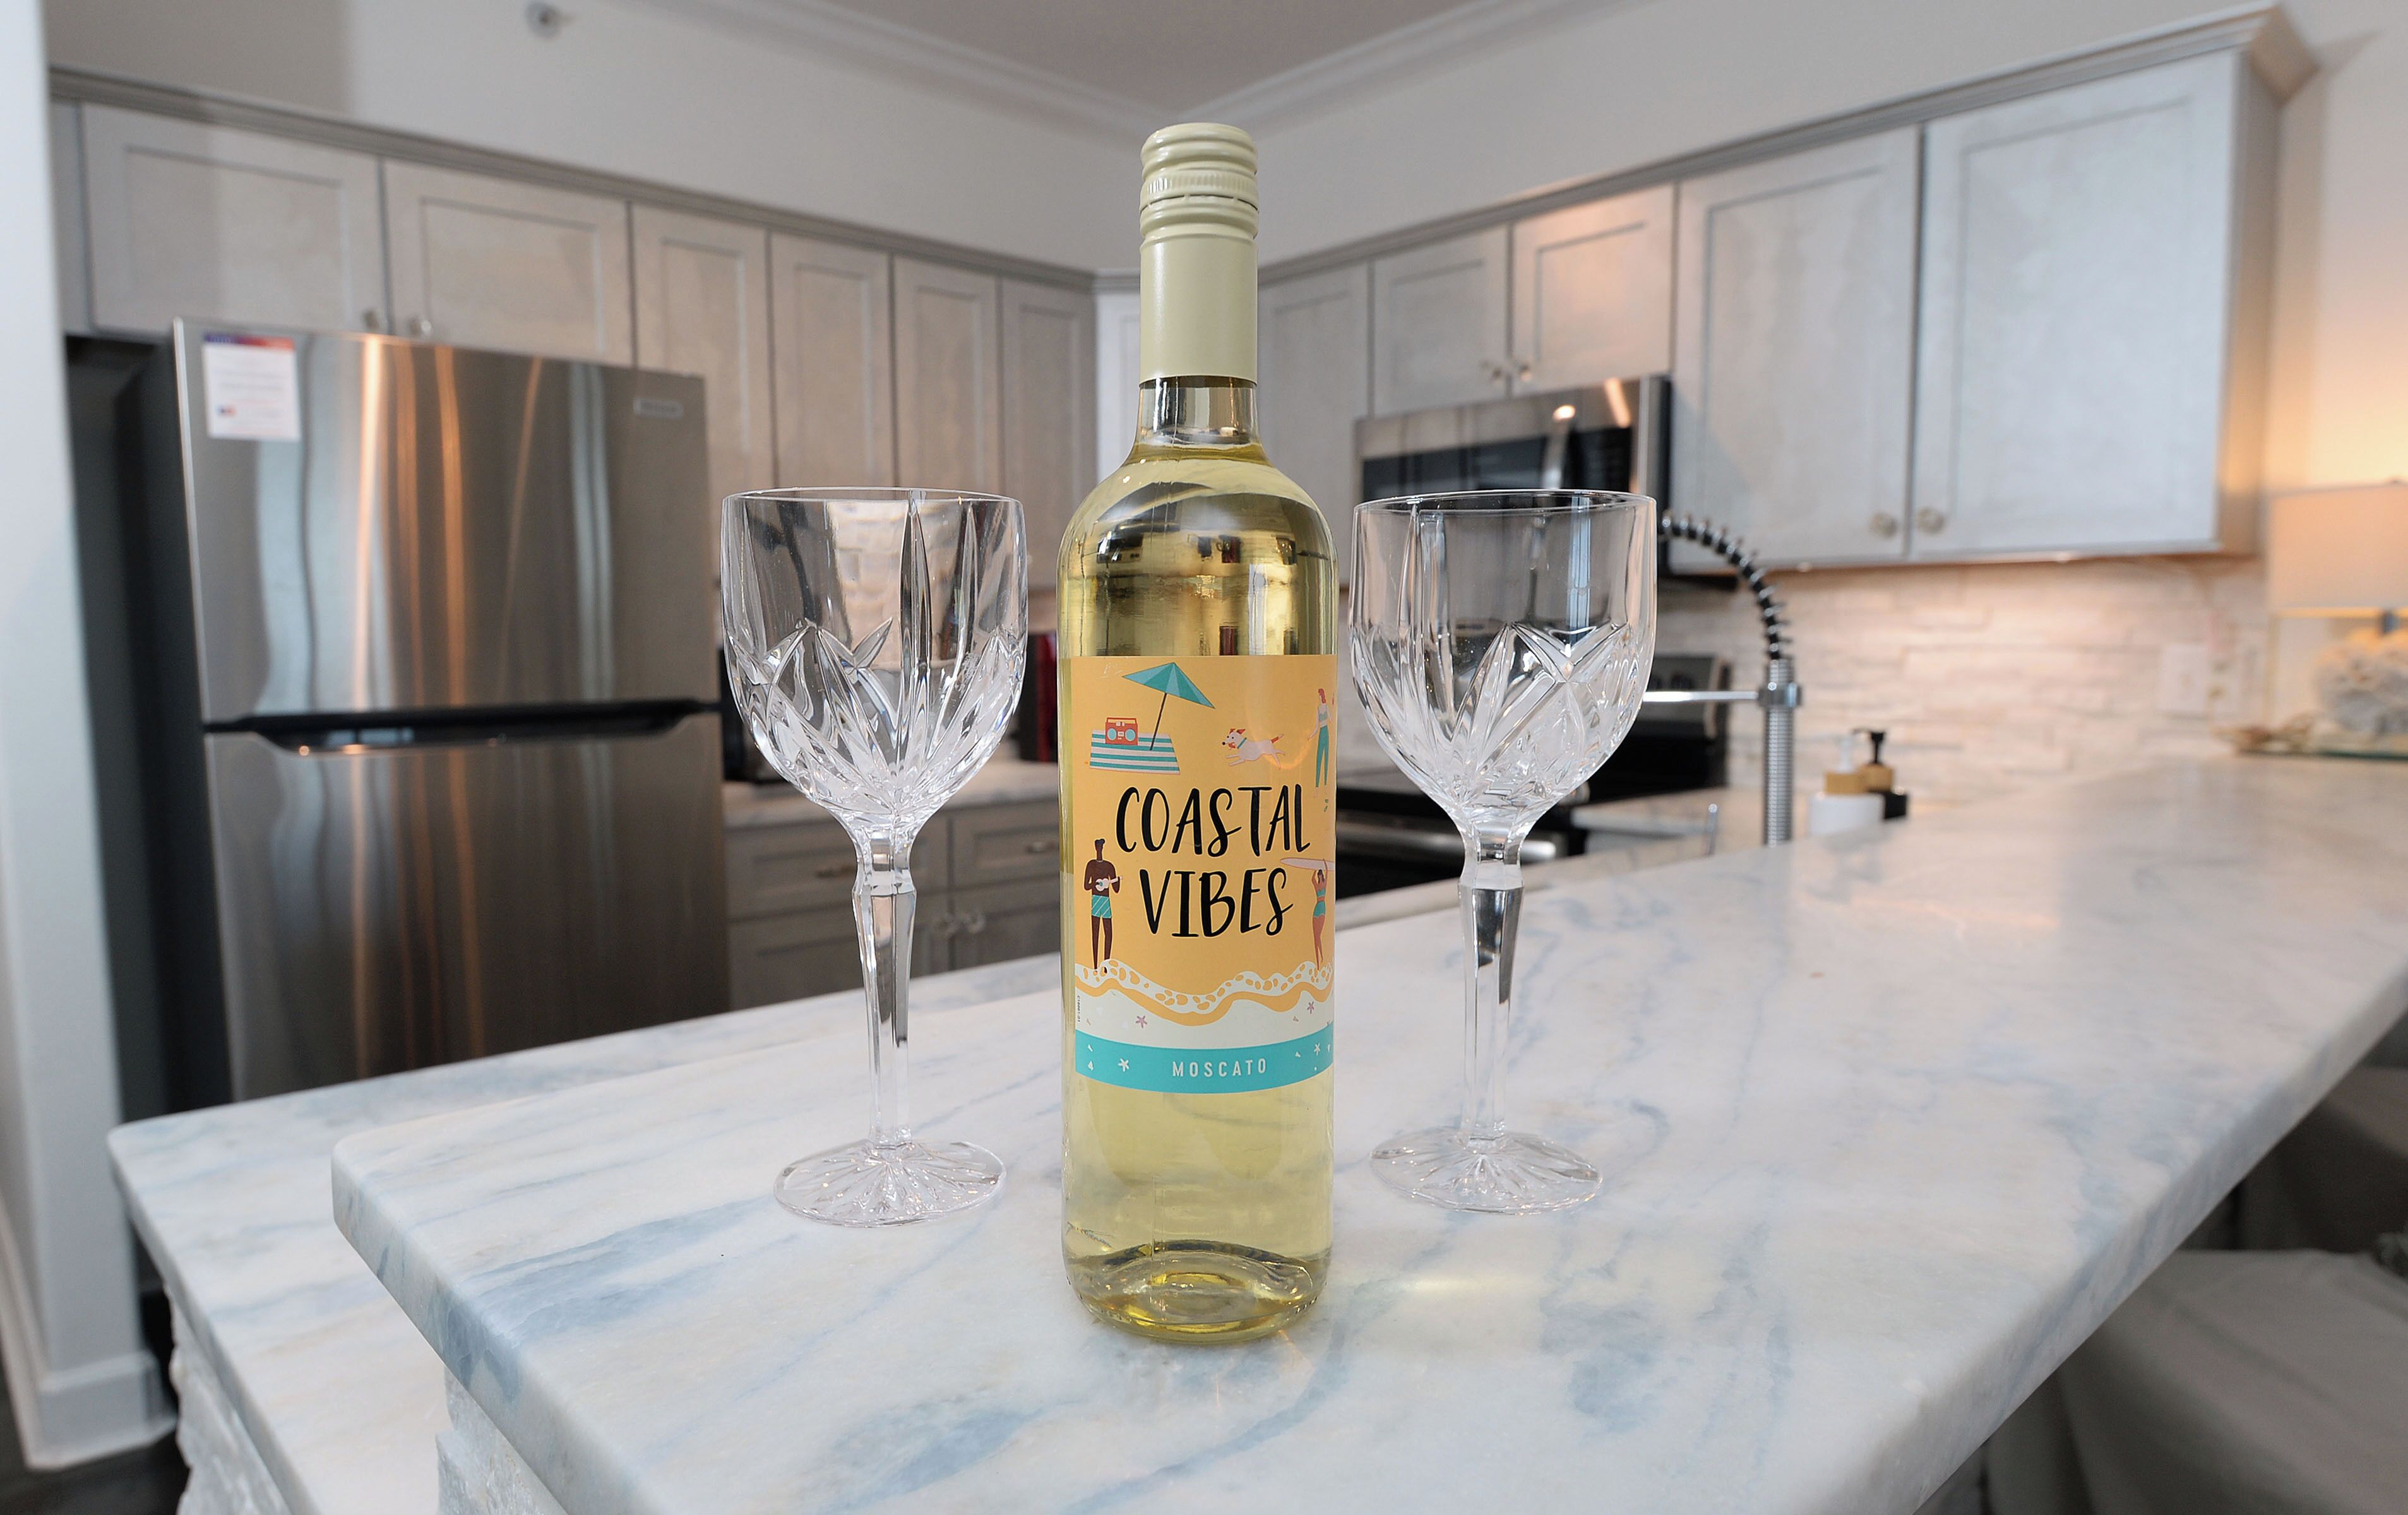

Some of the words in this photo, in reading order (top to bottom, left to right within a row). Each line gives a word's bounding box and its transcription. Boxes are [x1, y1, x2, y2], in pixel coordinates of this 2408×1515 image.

[1116, 784, 1311, 857] COASTAL
[1140, 868, 1294, 937] VIBES
[1172, 1058, 1266, 1077] MOSCATO
